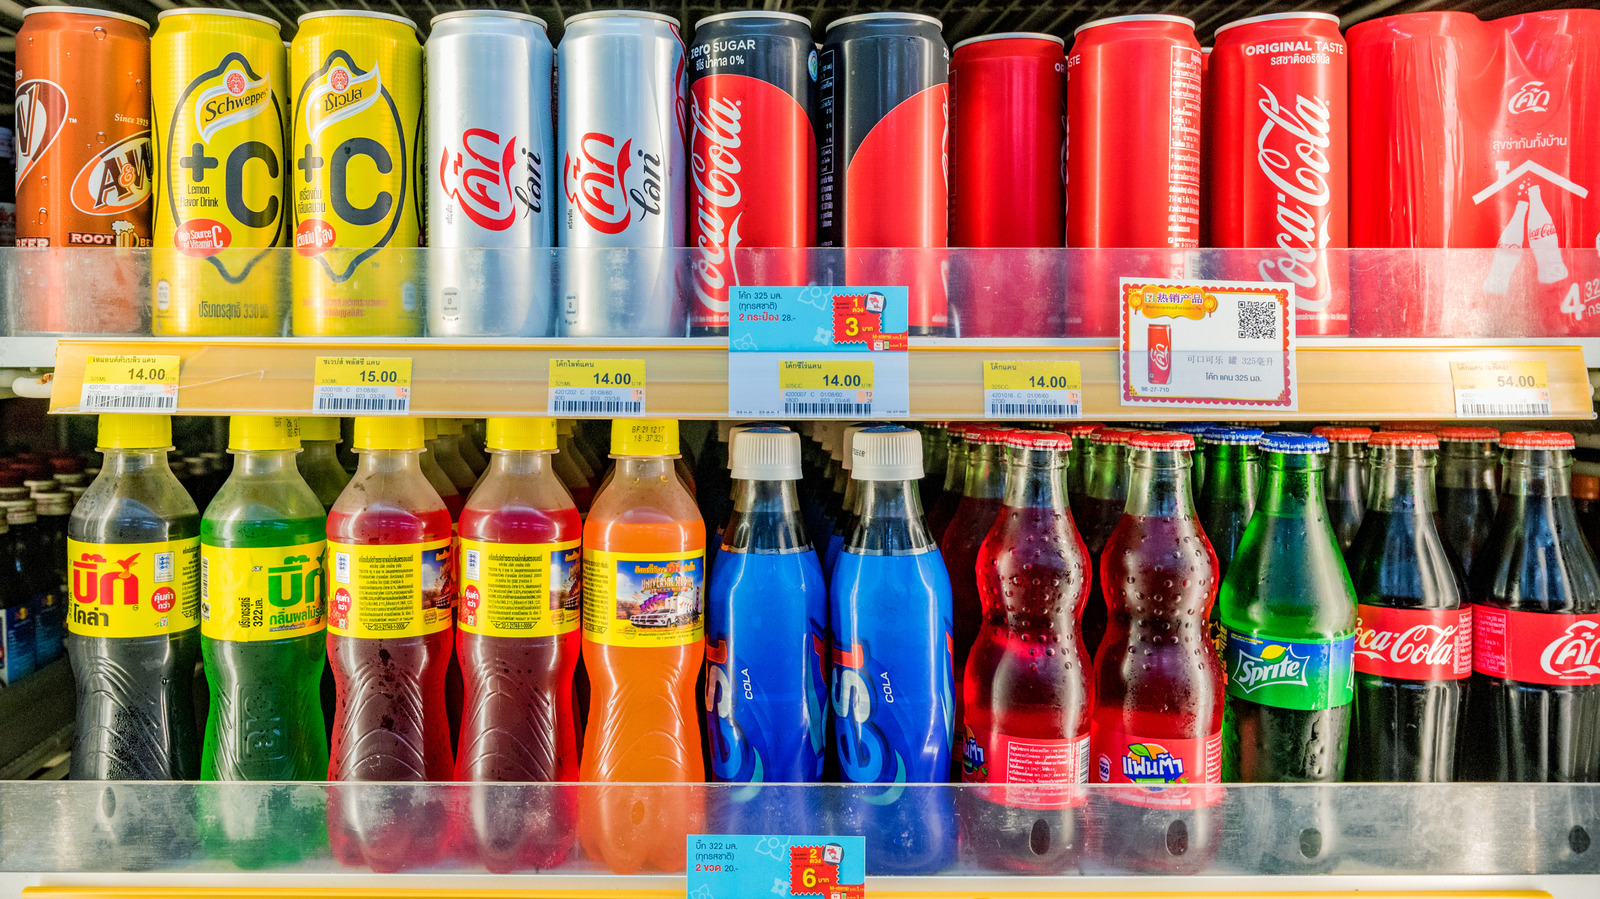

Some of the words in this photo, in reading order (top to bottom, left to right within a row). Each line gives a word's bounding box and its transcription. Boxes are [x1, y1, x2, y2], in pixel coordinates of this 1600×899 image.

[691, 44, 711, 60] zero
[713, 39, 756, 53] SUGAR
[1246, 40, 1312, 57] ORIGINAL
[1314, 40, 1344, 56] TASTE
[729, 55, 745, 65] 0%
[205, 88, 268, 122] Schweppes
[114, 113, 135, 124] Since
[187, 184, 210, 195] Lemon
[200, 197, 219, 208] Drink
[692, 88, 743, 313] Coca-Cola
[1258, 83, 1331, 313] Coca-Cola
[70, 233, 115, 245] ROOT
[190, 230, 212, 240] Source
[211, 225, 224, 249] C
[190, 239, 213, 249] Vitamin
[738, 291, 751, 299] โค้ก
[1156, 292, 1203, 304] 热销产品
[1560, 282, 1586, 321] 4
[853, 298, 858, 308] 1
[747, 312, 779, 321] กระป๋อง
[845, 317, 859, 337] 3
[1187, 354, 1224, 365] 可口可乐
[1241, 356, 1275, 367] 325毫升
[128, 368, 166, 381] 14.00
[360, 370, 398, 383] 15.00
[594, 373, 632, 385] 14.00
[823, 375, 861, 387] 14.00
[1029, 376, 1067, 388] 14.00
[1497, 375, 1535, 388] 54.00
[74, 603, 109, 627] โคล่า
[1239, 656, 1301, 687] Sprite
[741, 668, 754, 700] COLA
[880, 671, 895, 703] COLA
[1122, 753, 1184, 776] แฟนต้า
[810, 849, 818, 858] 2
[803, 868, 817, 888] 6
